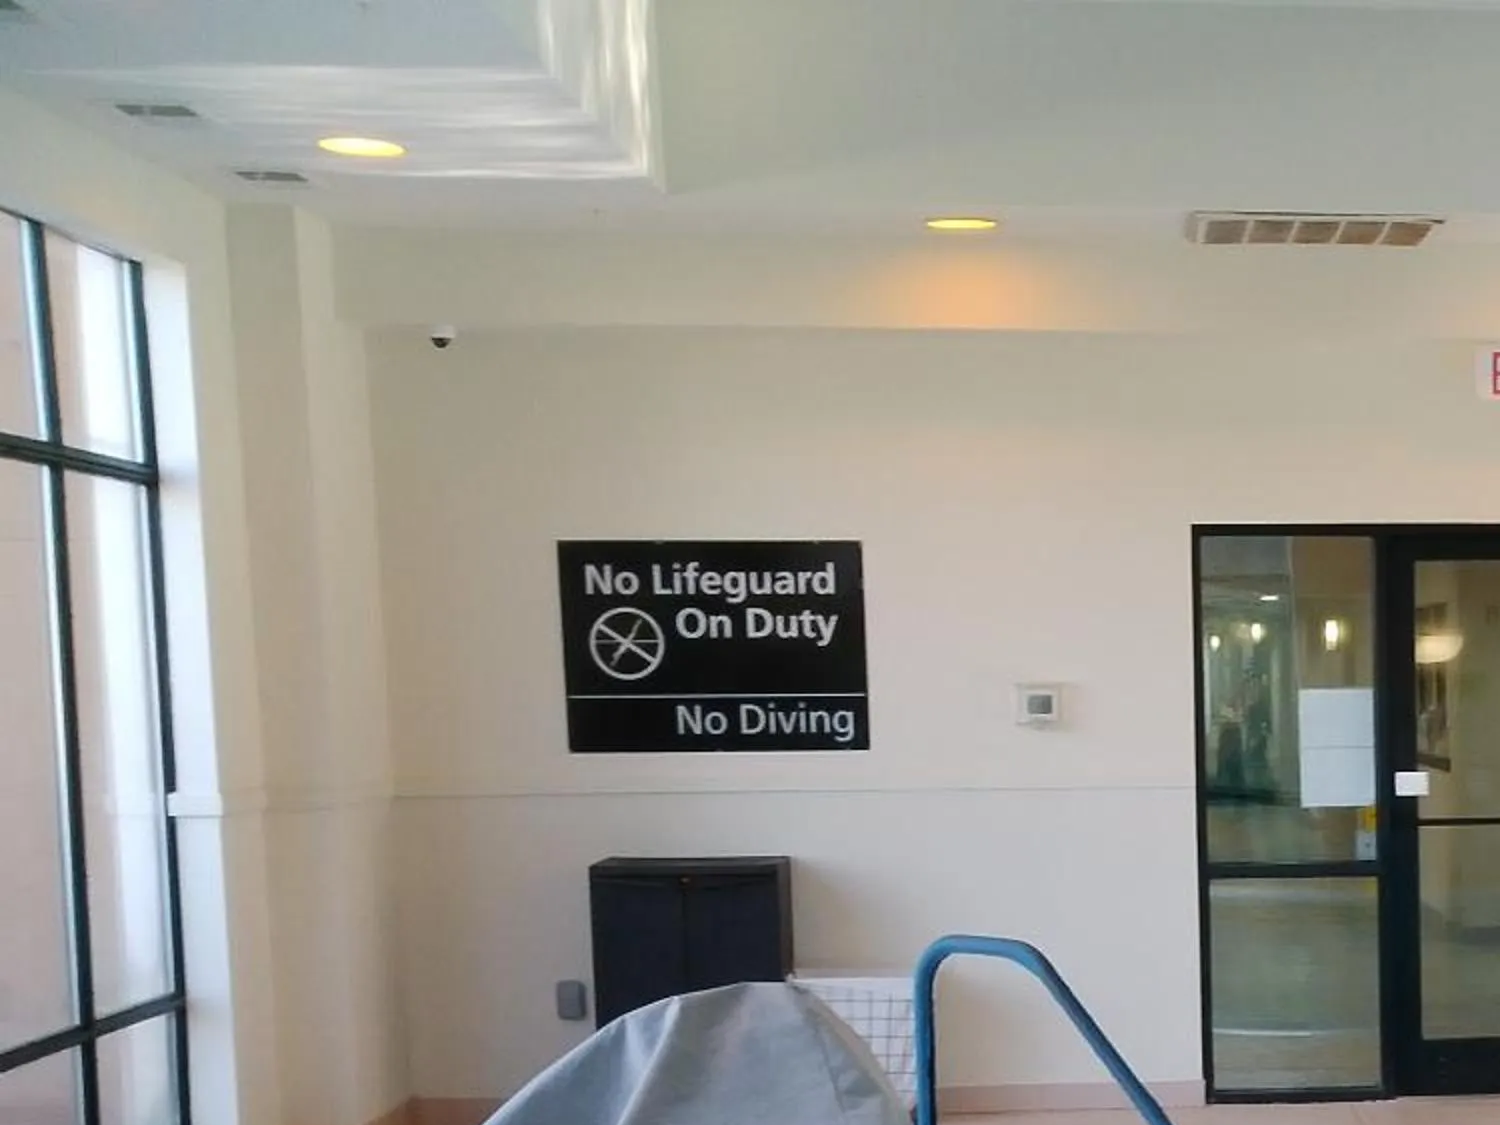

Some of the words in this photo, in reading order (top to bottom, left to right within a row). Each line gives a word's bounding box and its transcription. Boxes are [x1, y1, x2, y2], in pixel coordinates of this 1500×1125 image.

[583, 563, 639, 595] No
[651, 561, 836, 603] Lifeguard
[675, 607, 733, 639] On
[745, 607, 838, 646] Duty
[676, 704, 729, 735] No
[739, 702, 855, 742] Diving
